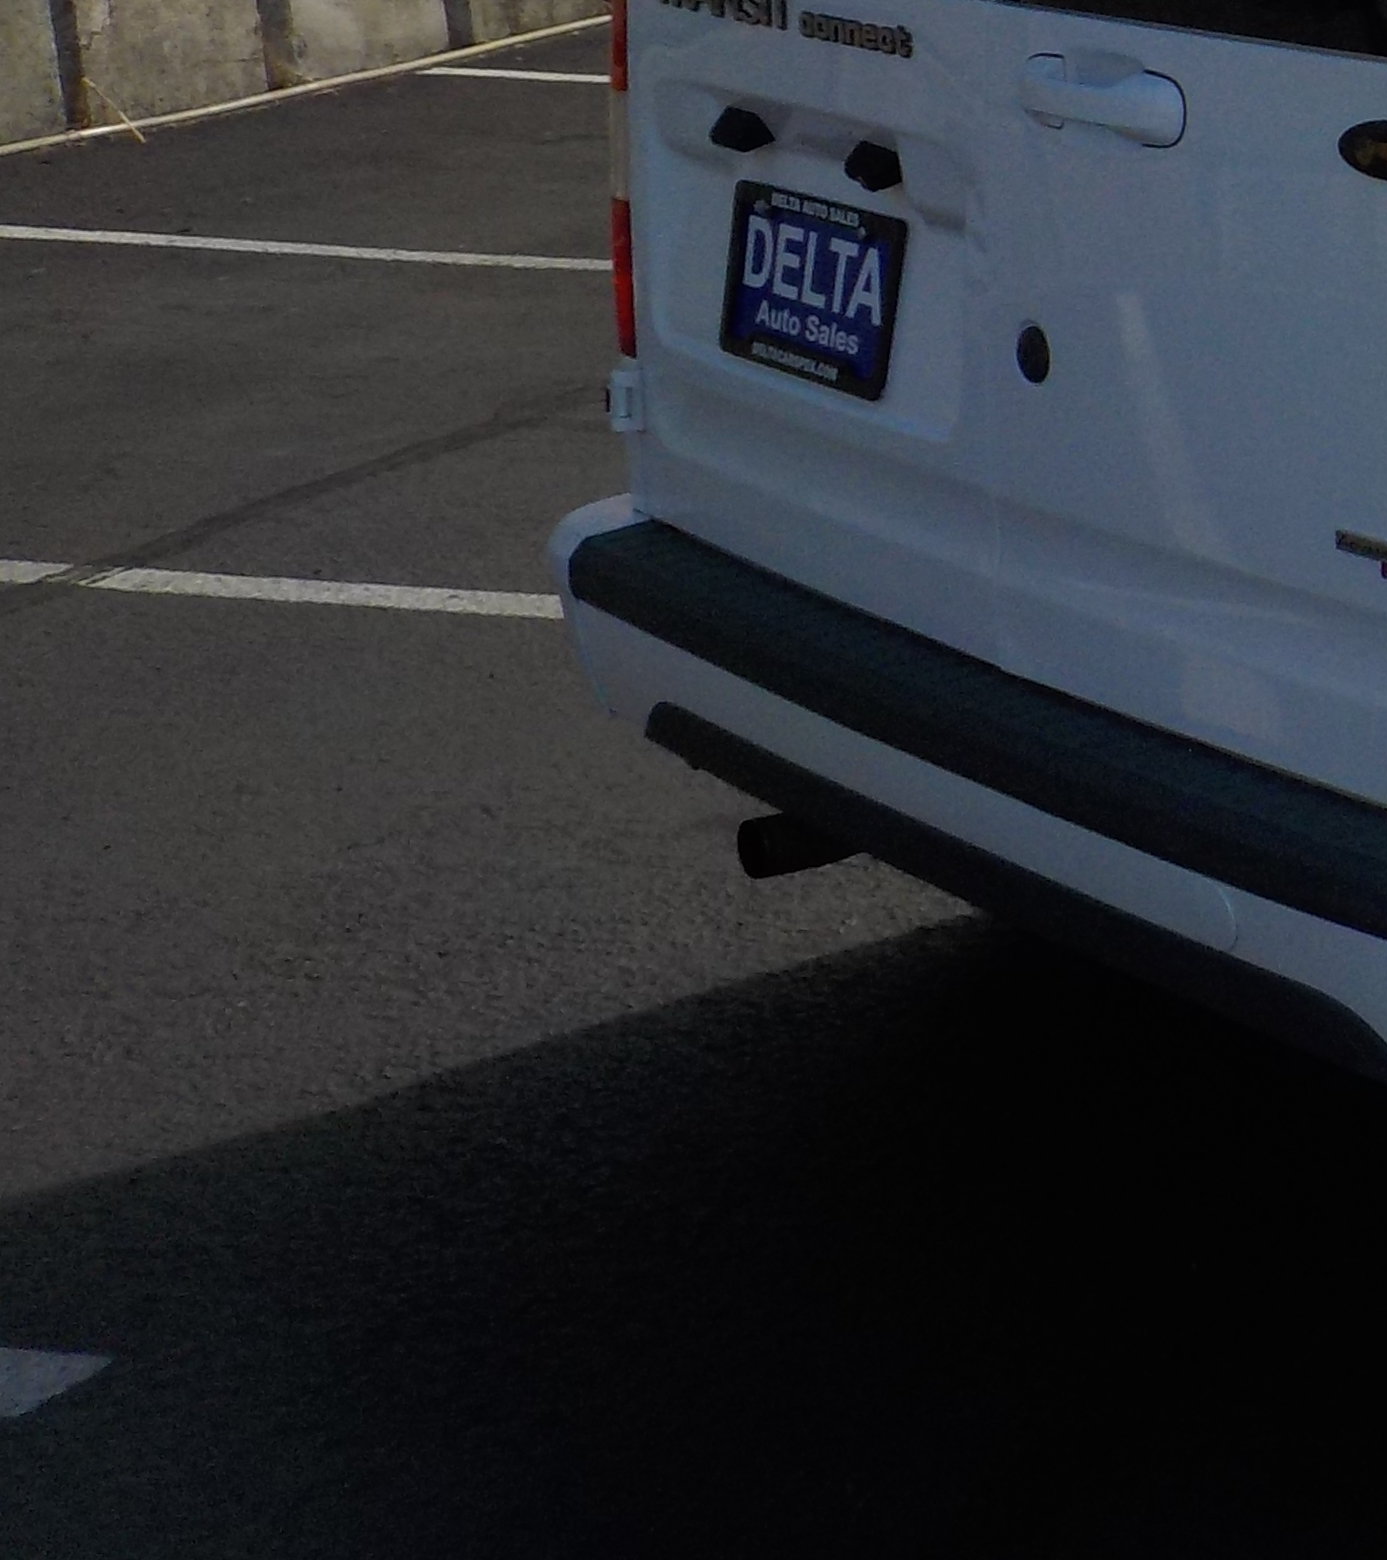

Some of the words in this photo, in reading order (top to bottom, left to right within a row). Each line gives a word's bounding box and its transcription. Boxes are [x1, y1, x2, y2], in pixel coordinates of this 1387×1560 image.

[799, 10, 913, 59] connect
[743, 214, 882, 327] DELTA
[755, 299, 800, 337] Auto
[805, 314, 859, 356] Sales
